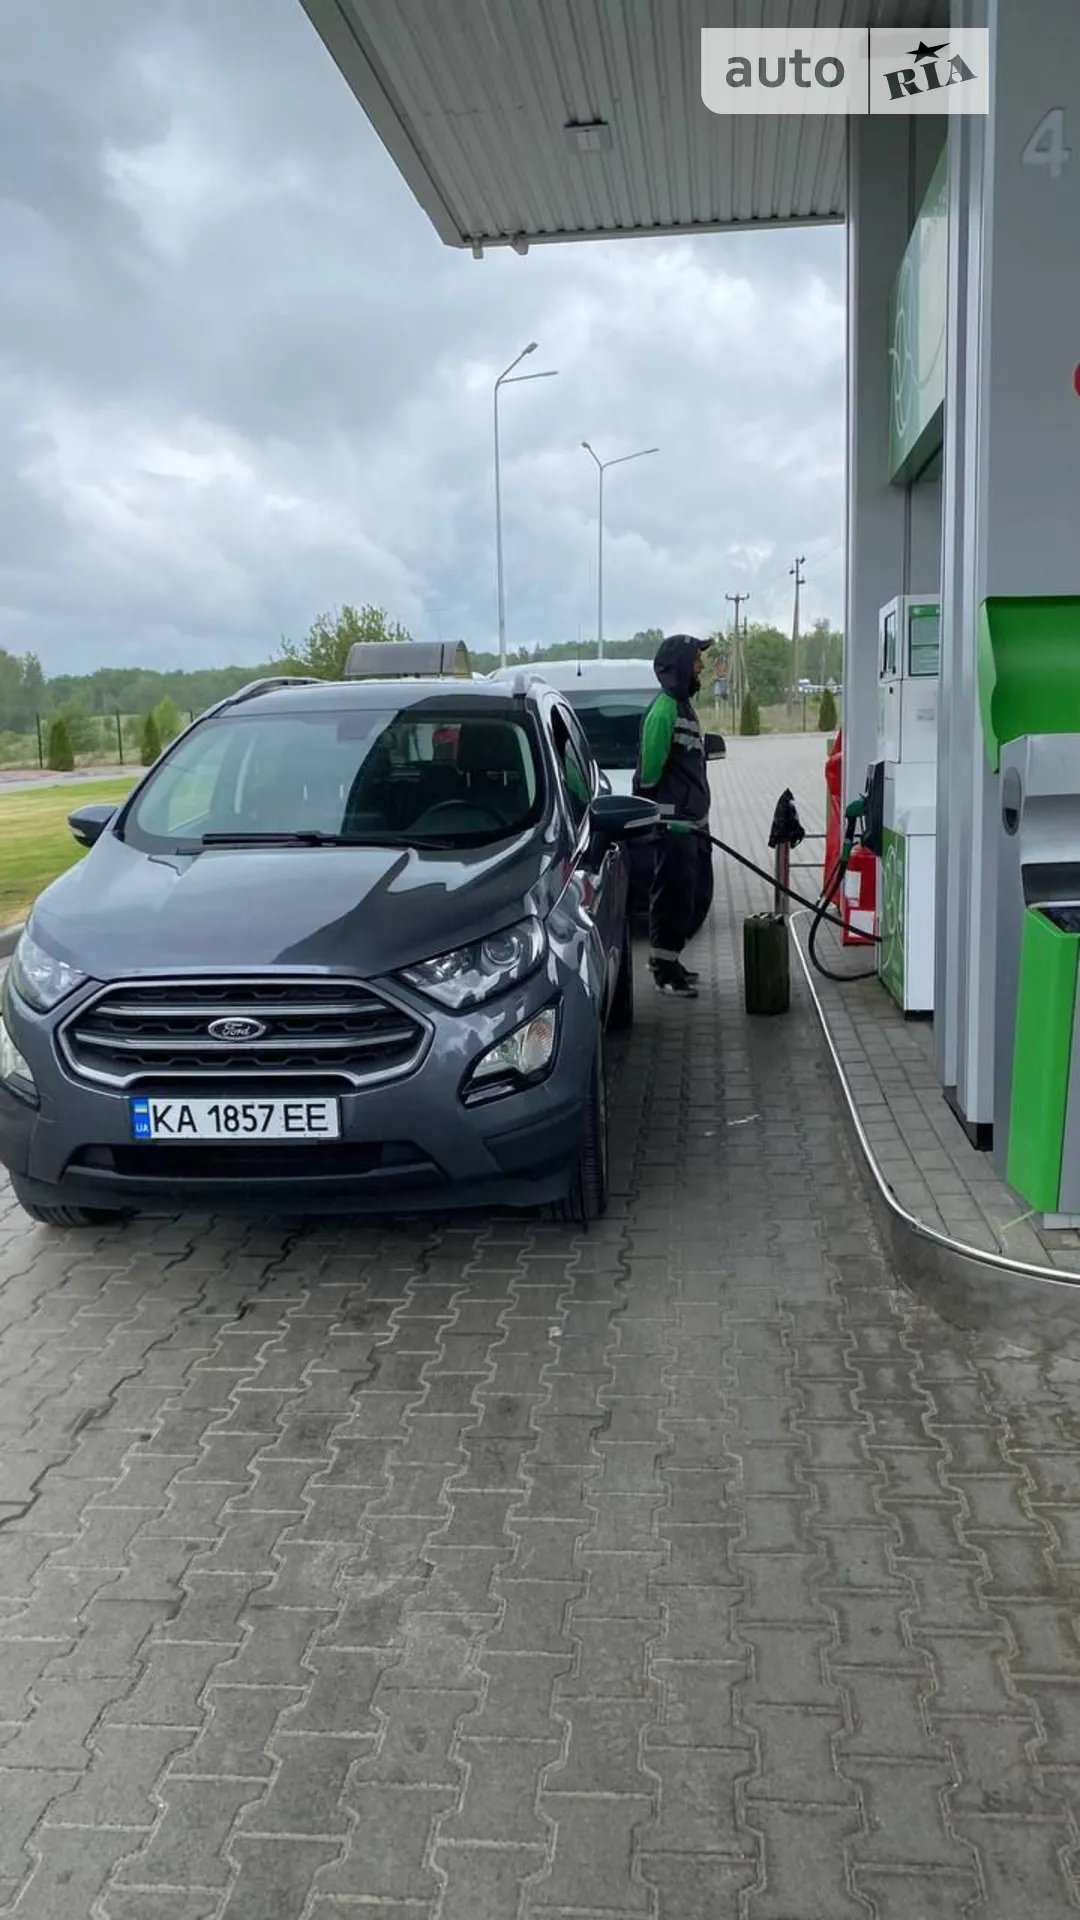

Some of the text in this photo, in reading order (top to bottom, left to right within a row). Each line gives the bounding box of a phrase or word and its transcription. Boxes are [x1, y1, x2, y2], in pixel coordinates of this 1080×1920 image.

[1020, 106, 1073, 178] 4
[222, 1022, 251, 1036] Ford
[152, 1103, 329, 1133] KA 1857 EE
